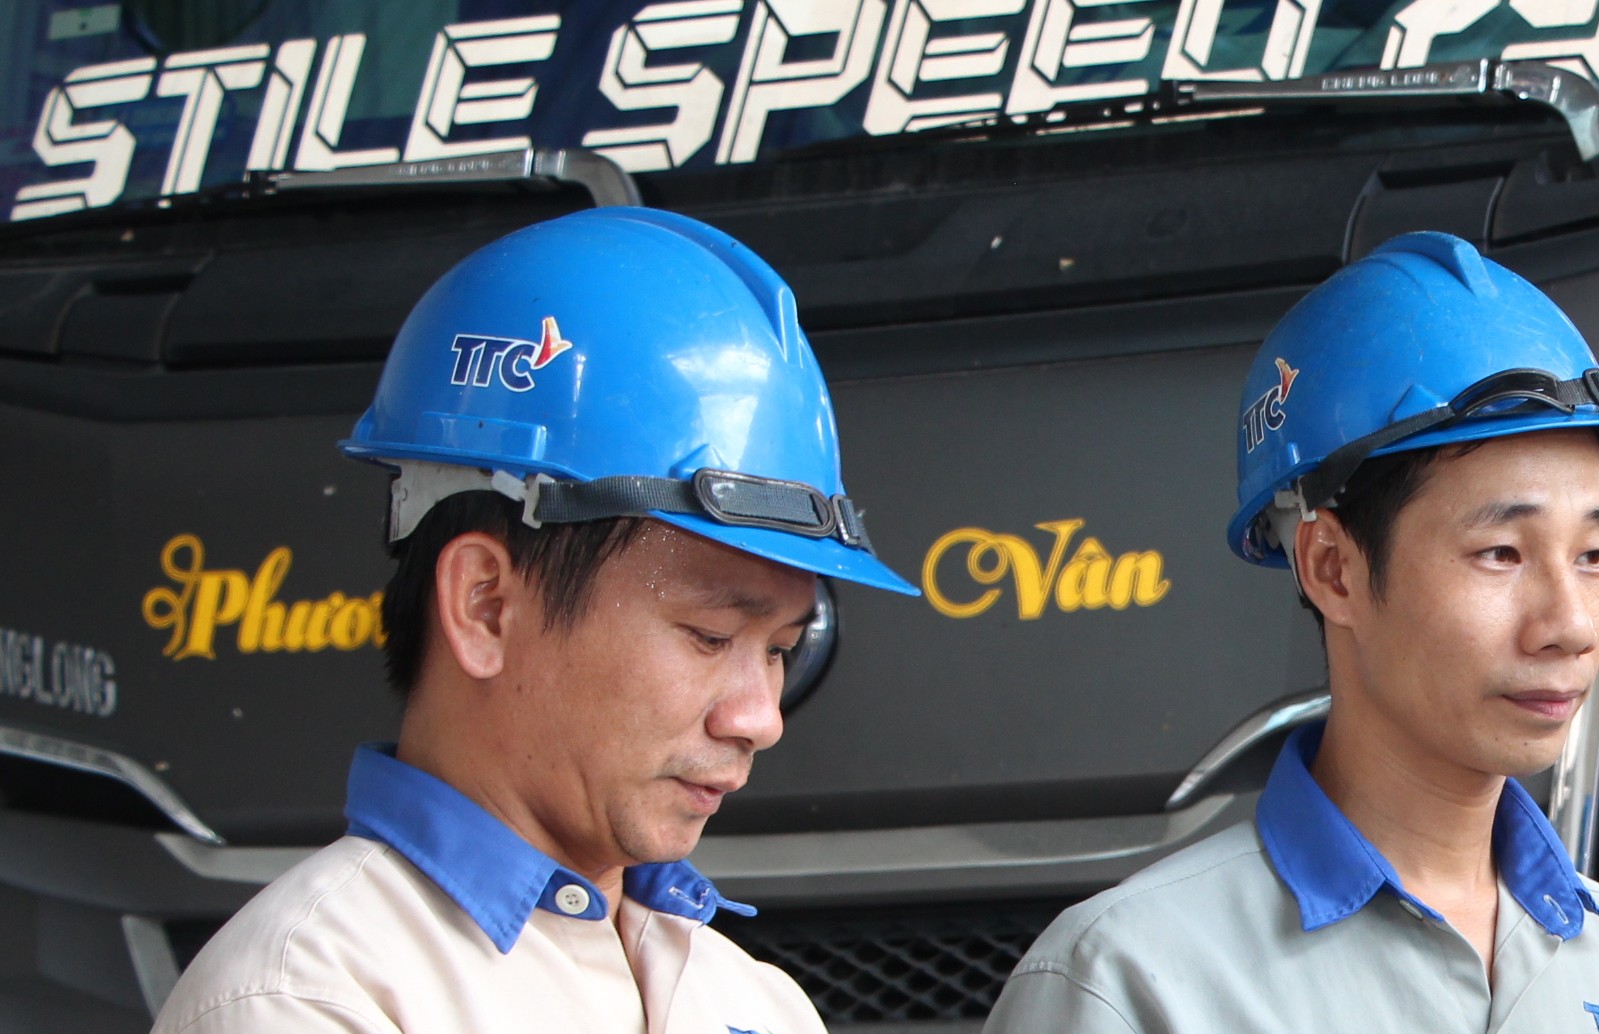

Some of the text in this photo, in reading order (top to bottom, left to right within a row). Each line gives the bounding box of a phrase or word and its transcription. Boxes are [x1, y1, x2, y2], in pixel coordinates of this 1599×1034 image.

[10, 15, 561, 221] STILE
[450, 333, 537, 393] TTC
[1243, 386, 1287, 454] TTC
[921, 517, 1171, 622] Vân
